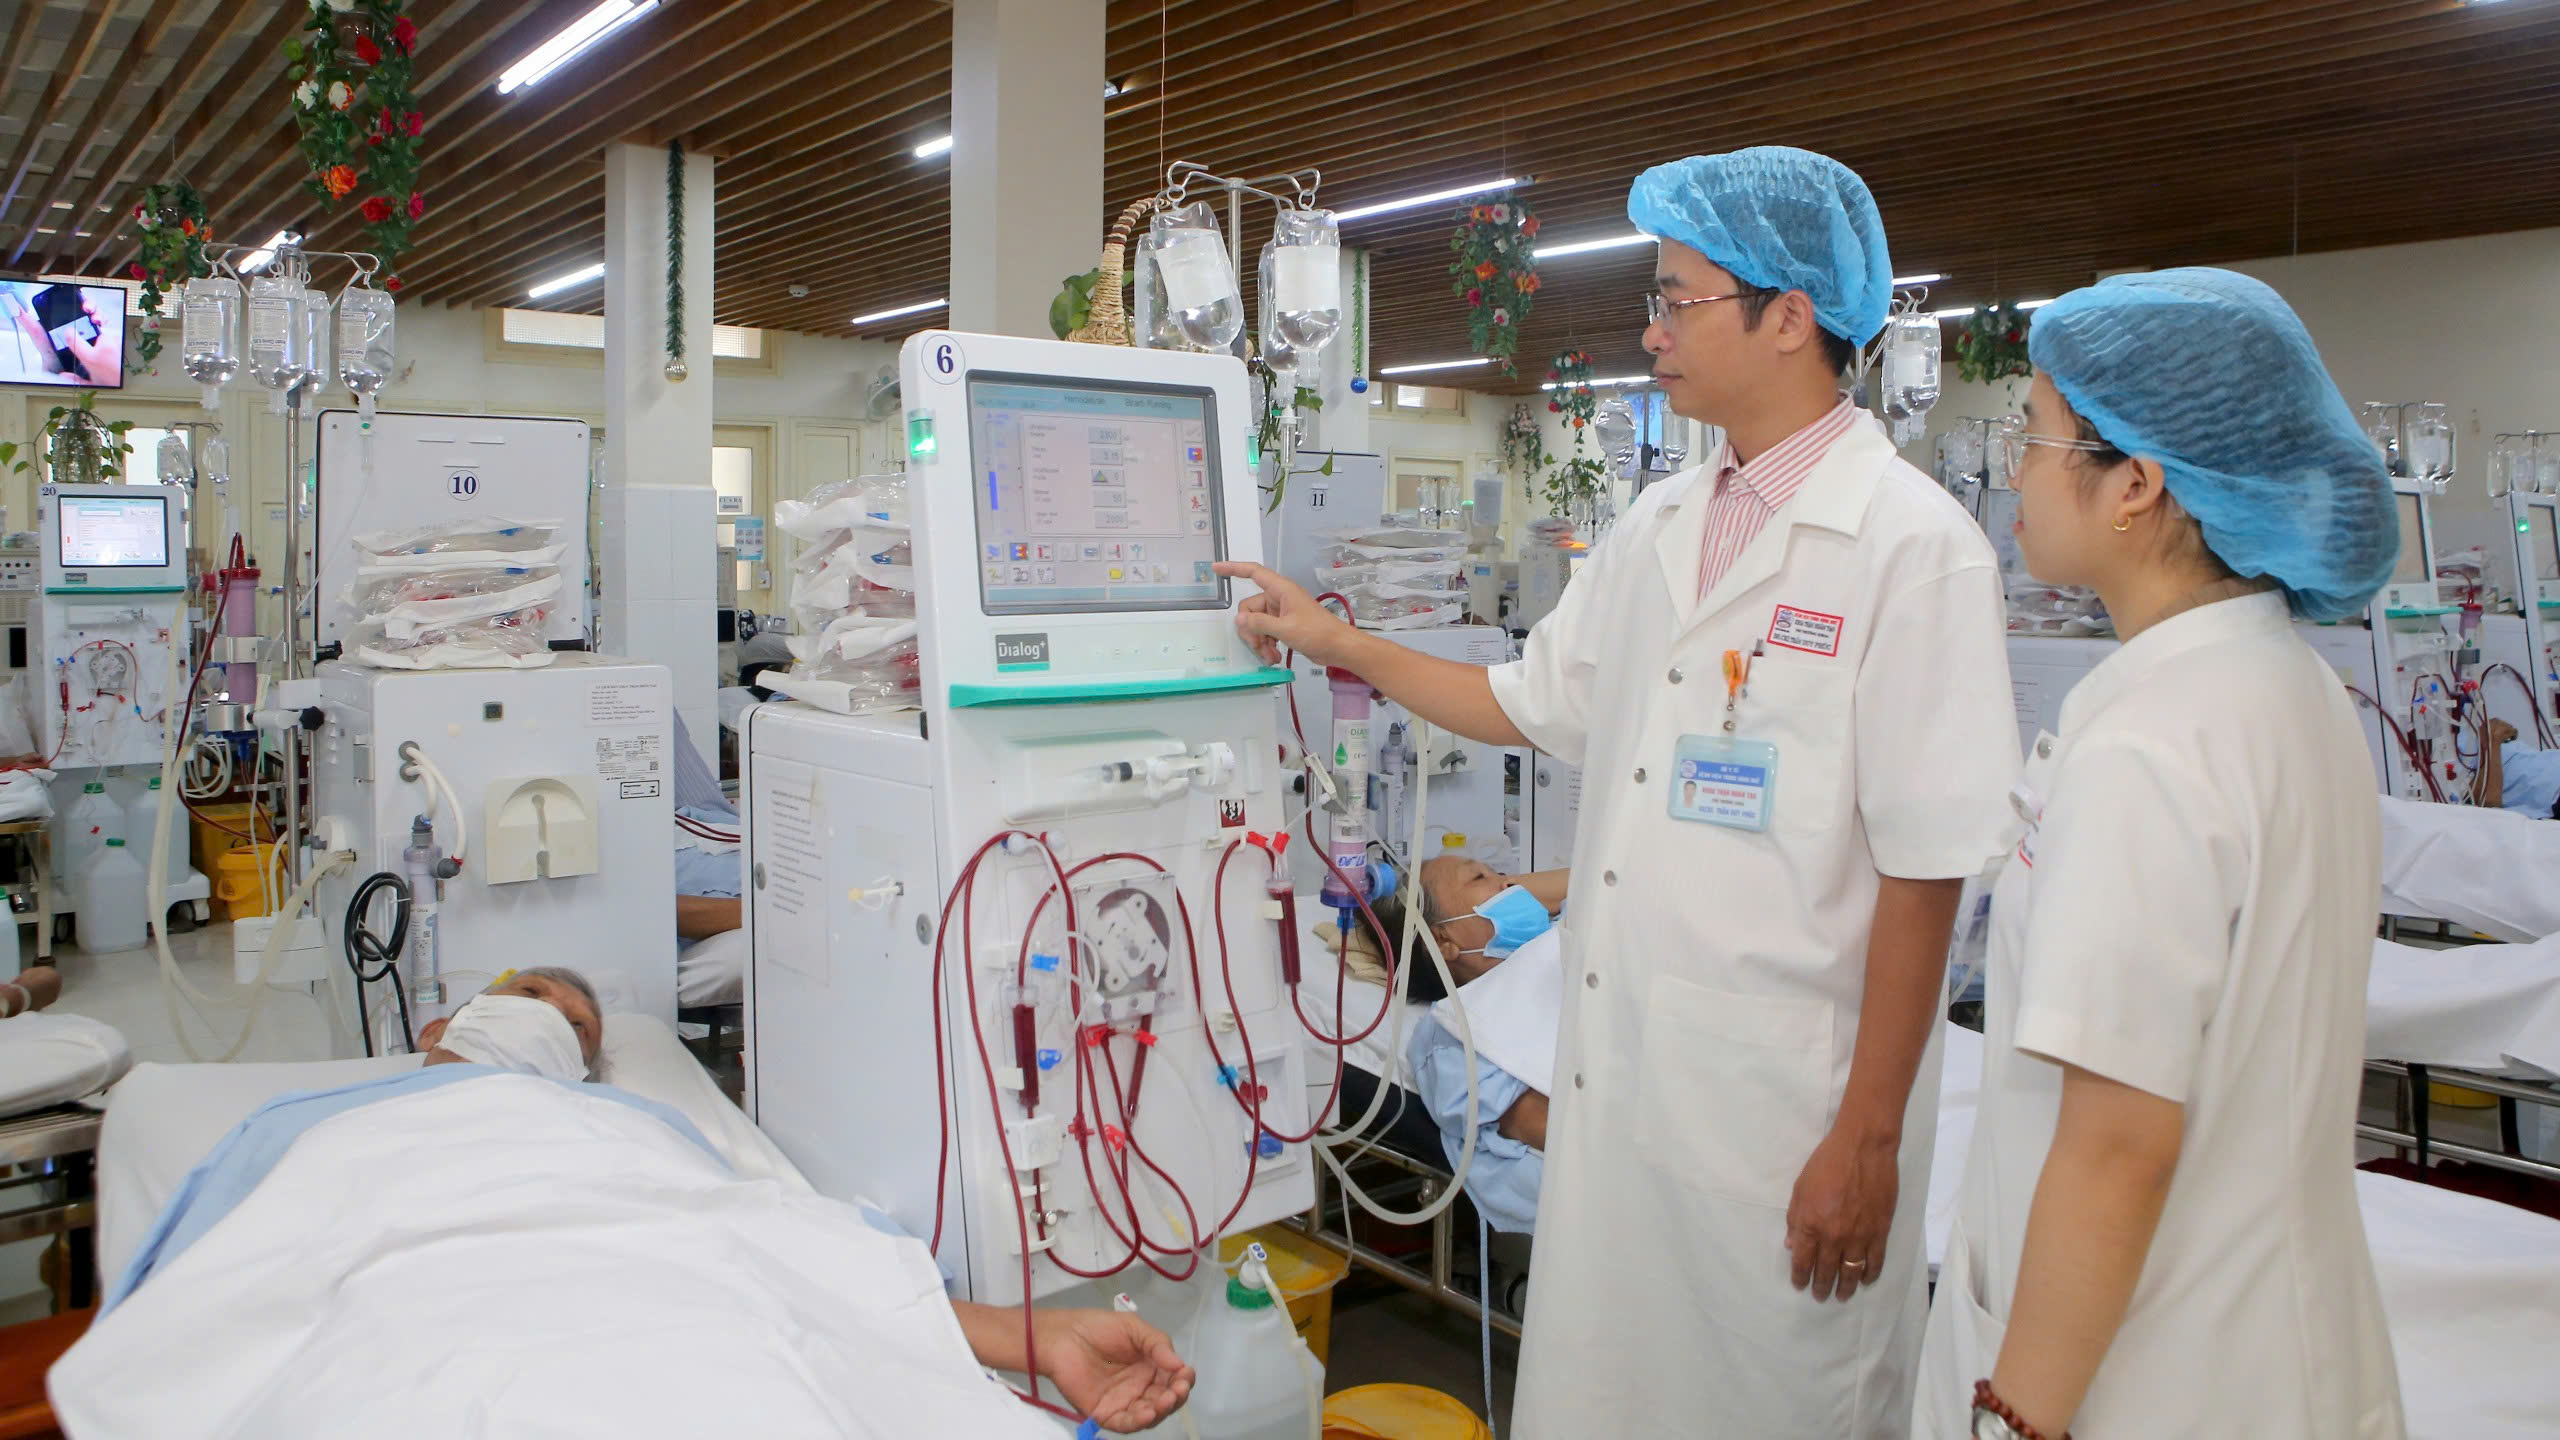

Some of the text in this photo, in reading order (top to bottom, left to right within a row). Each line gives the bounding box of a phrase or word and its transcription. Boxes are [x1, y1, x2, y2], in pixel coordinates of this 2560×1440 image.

[937, 345, 953, 373] 6
[42, 487, 56, 496] 20
[453, 476, 476, 494] 10
[1312, 493, 1325, 506] 11
